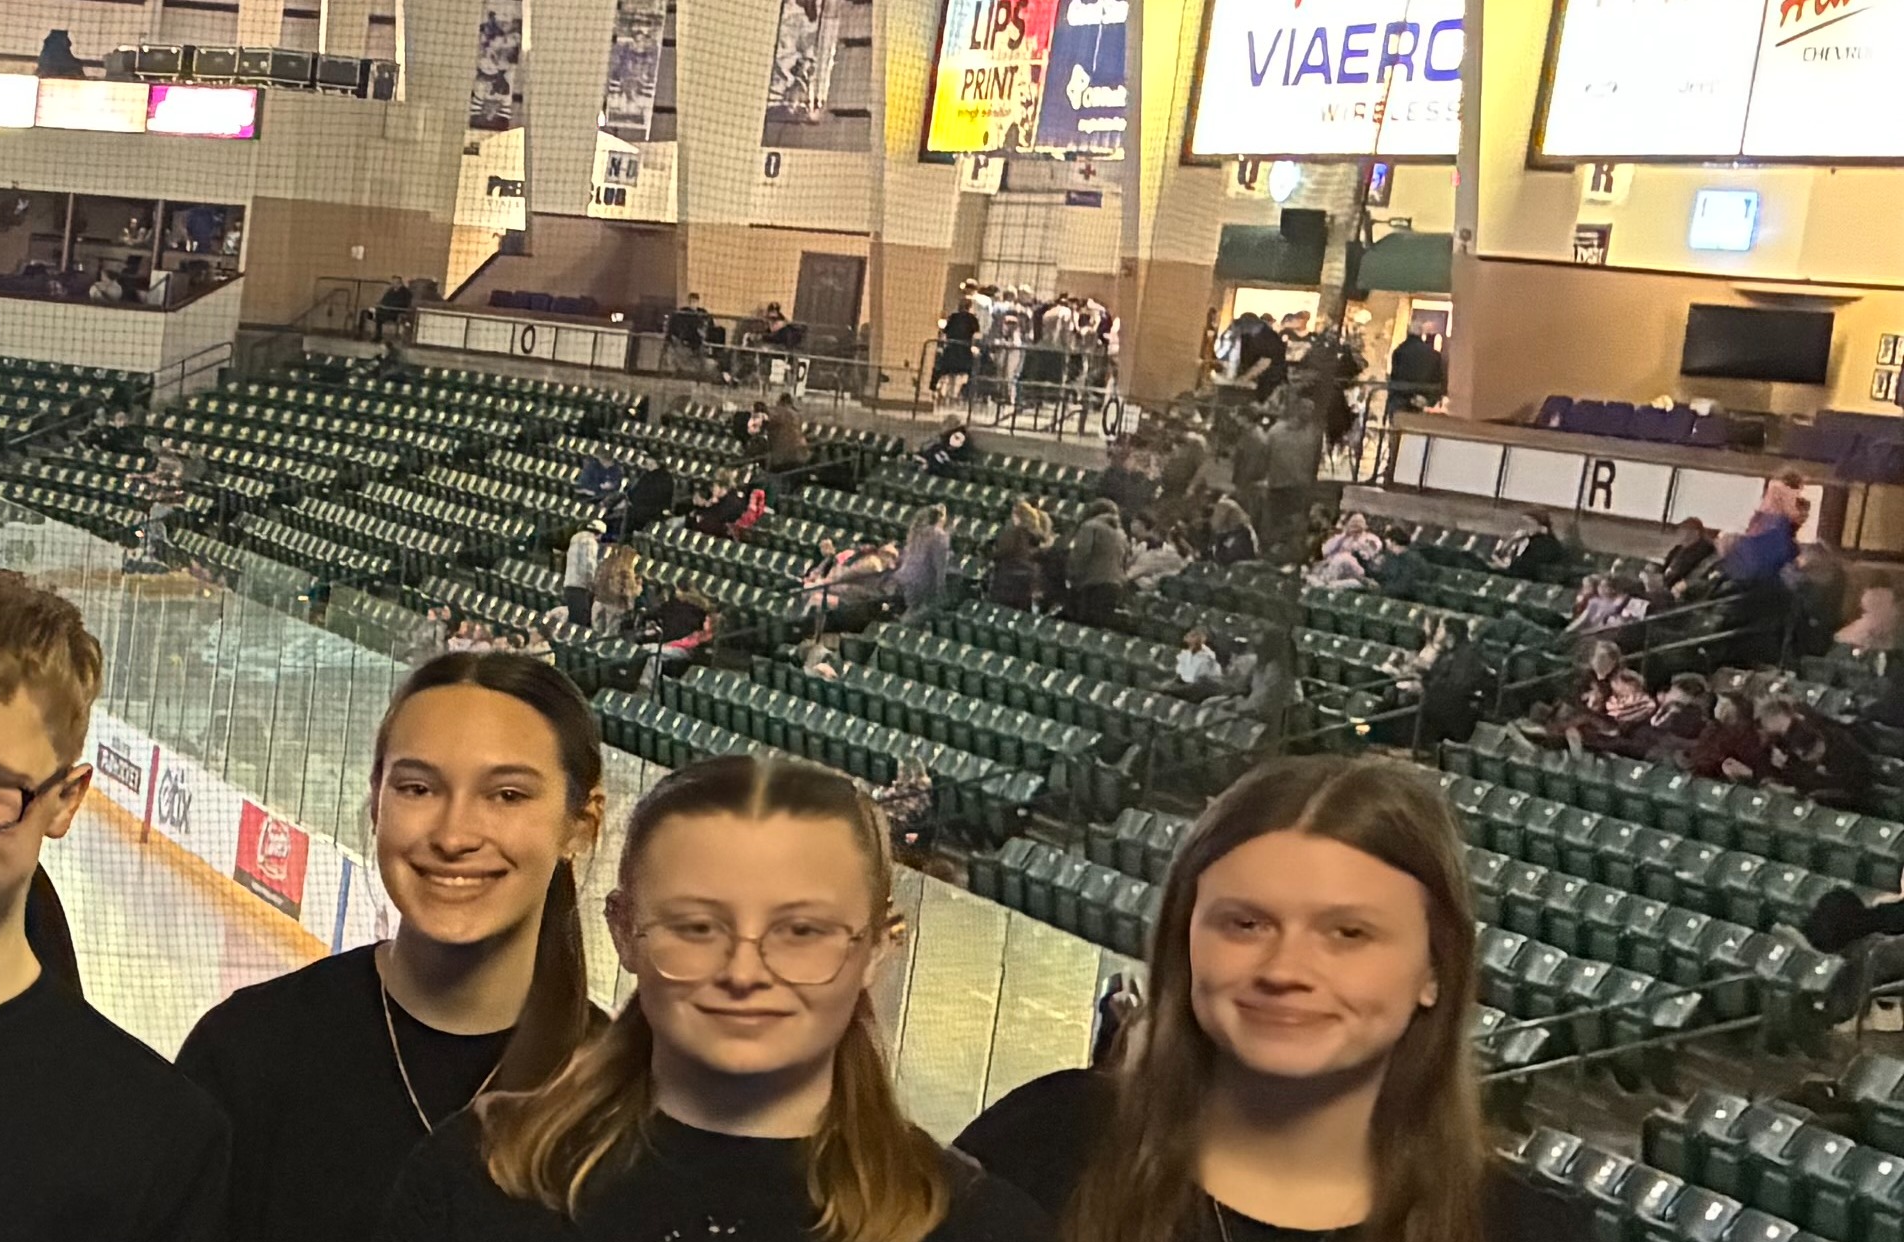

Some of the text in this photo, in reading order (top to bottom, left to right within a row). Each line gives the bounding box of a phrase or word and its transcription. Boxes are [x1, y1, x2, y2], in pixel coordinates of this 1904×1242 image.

[1248, 18, 1465, 87] VIAERO
[961, 65, 1019, 101] PRINT
[1591, 460, 1616, 510] R
